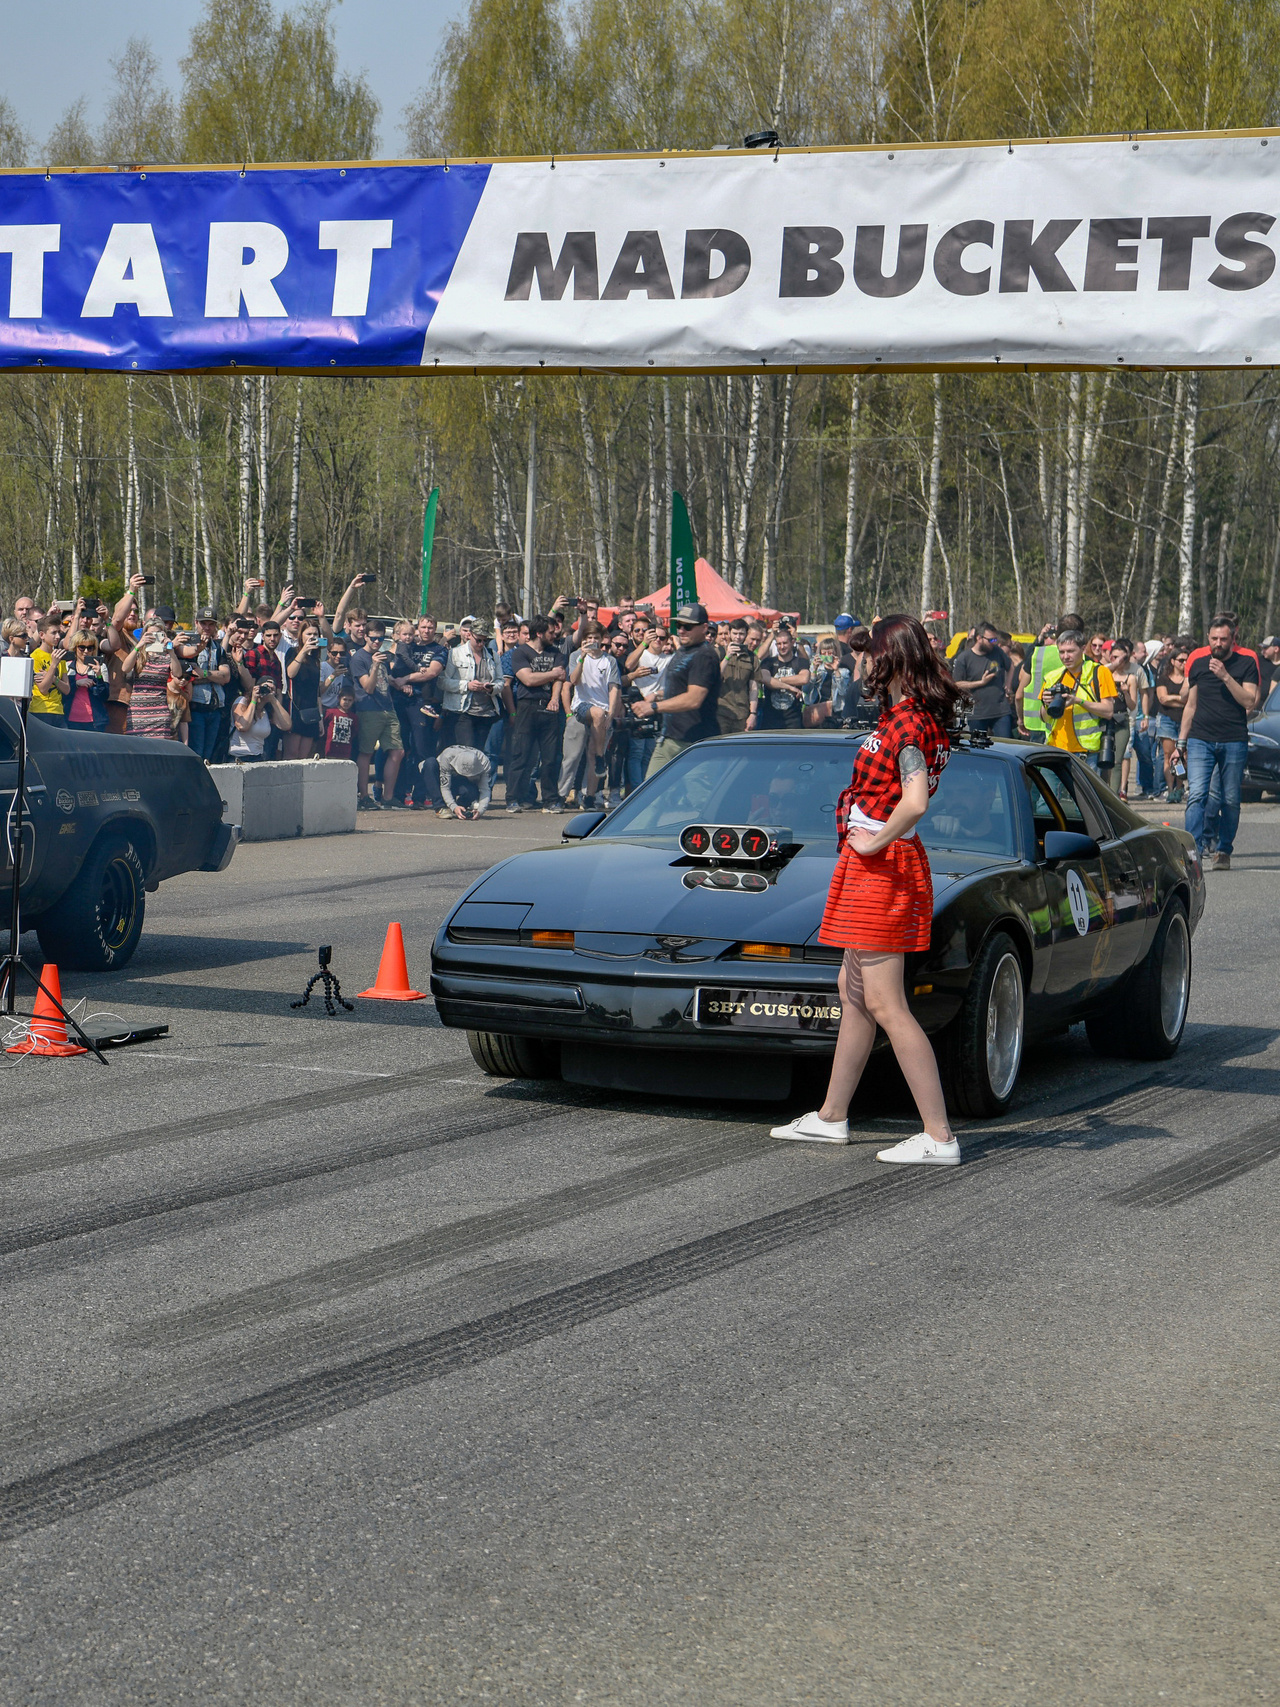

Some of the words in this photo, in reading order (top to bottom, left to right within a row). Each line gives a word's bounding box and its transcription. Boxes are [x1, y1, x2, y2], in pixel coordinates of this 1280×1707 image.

[505, 229, 751, 300] MAD
[779, 212, 1276, 297] BUCKETS
[1071, 882, 1083, 911] 11
[708, 1001, 746, 1014] 3BT
[749, 1002, 842, 1019] CUSTOMS
